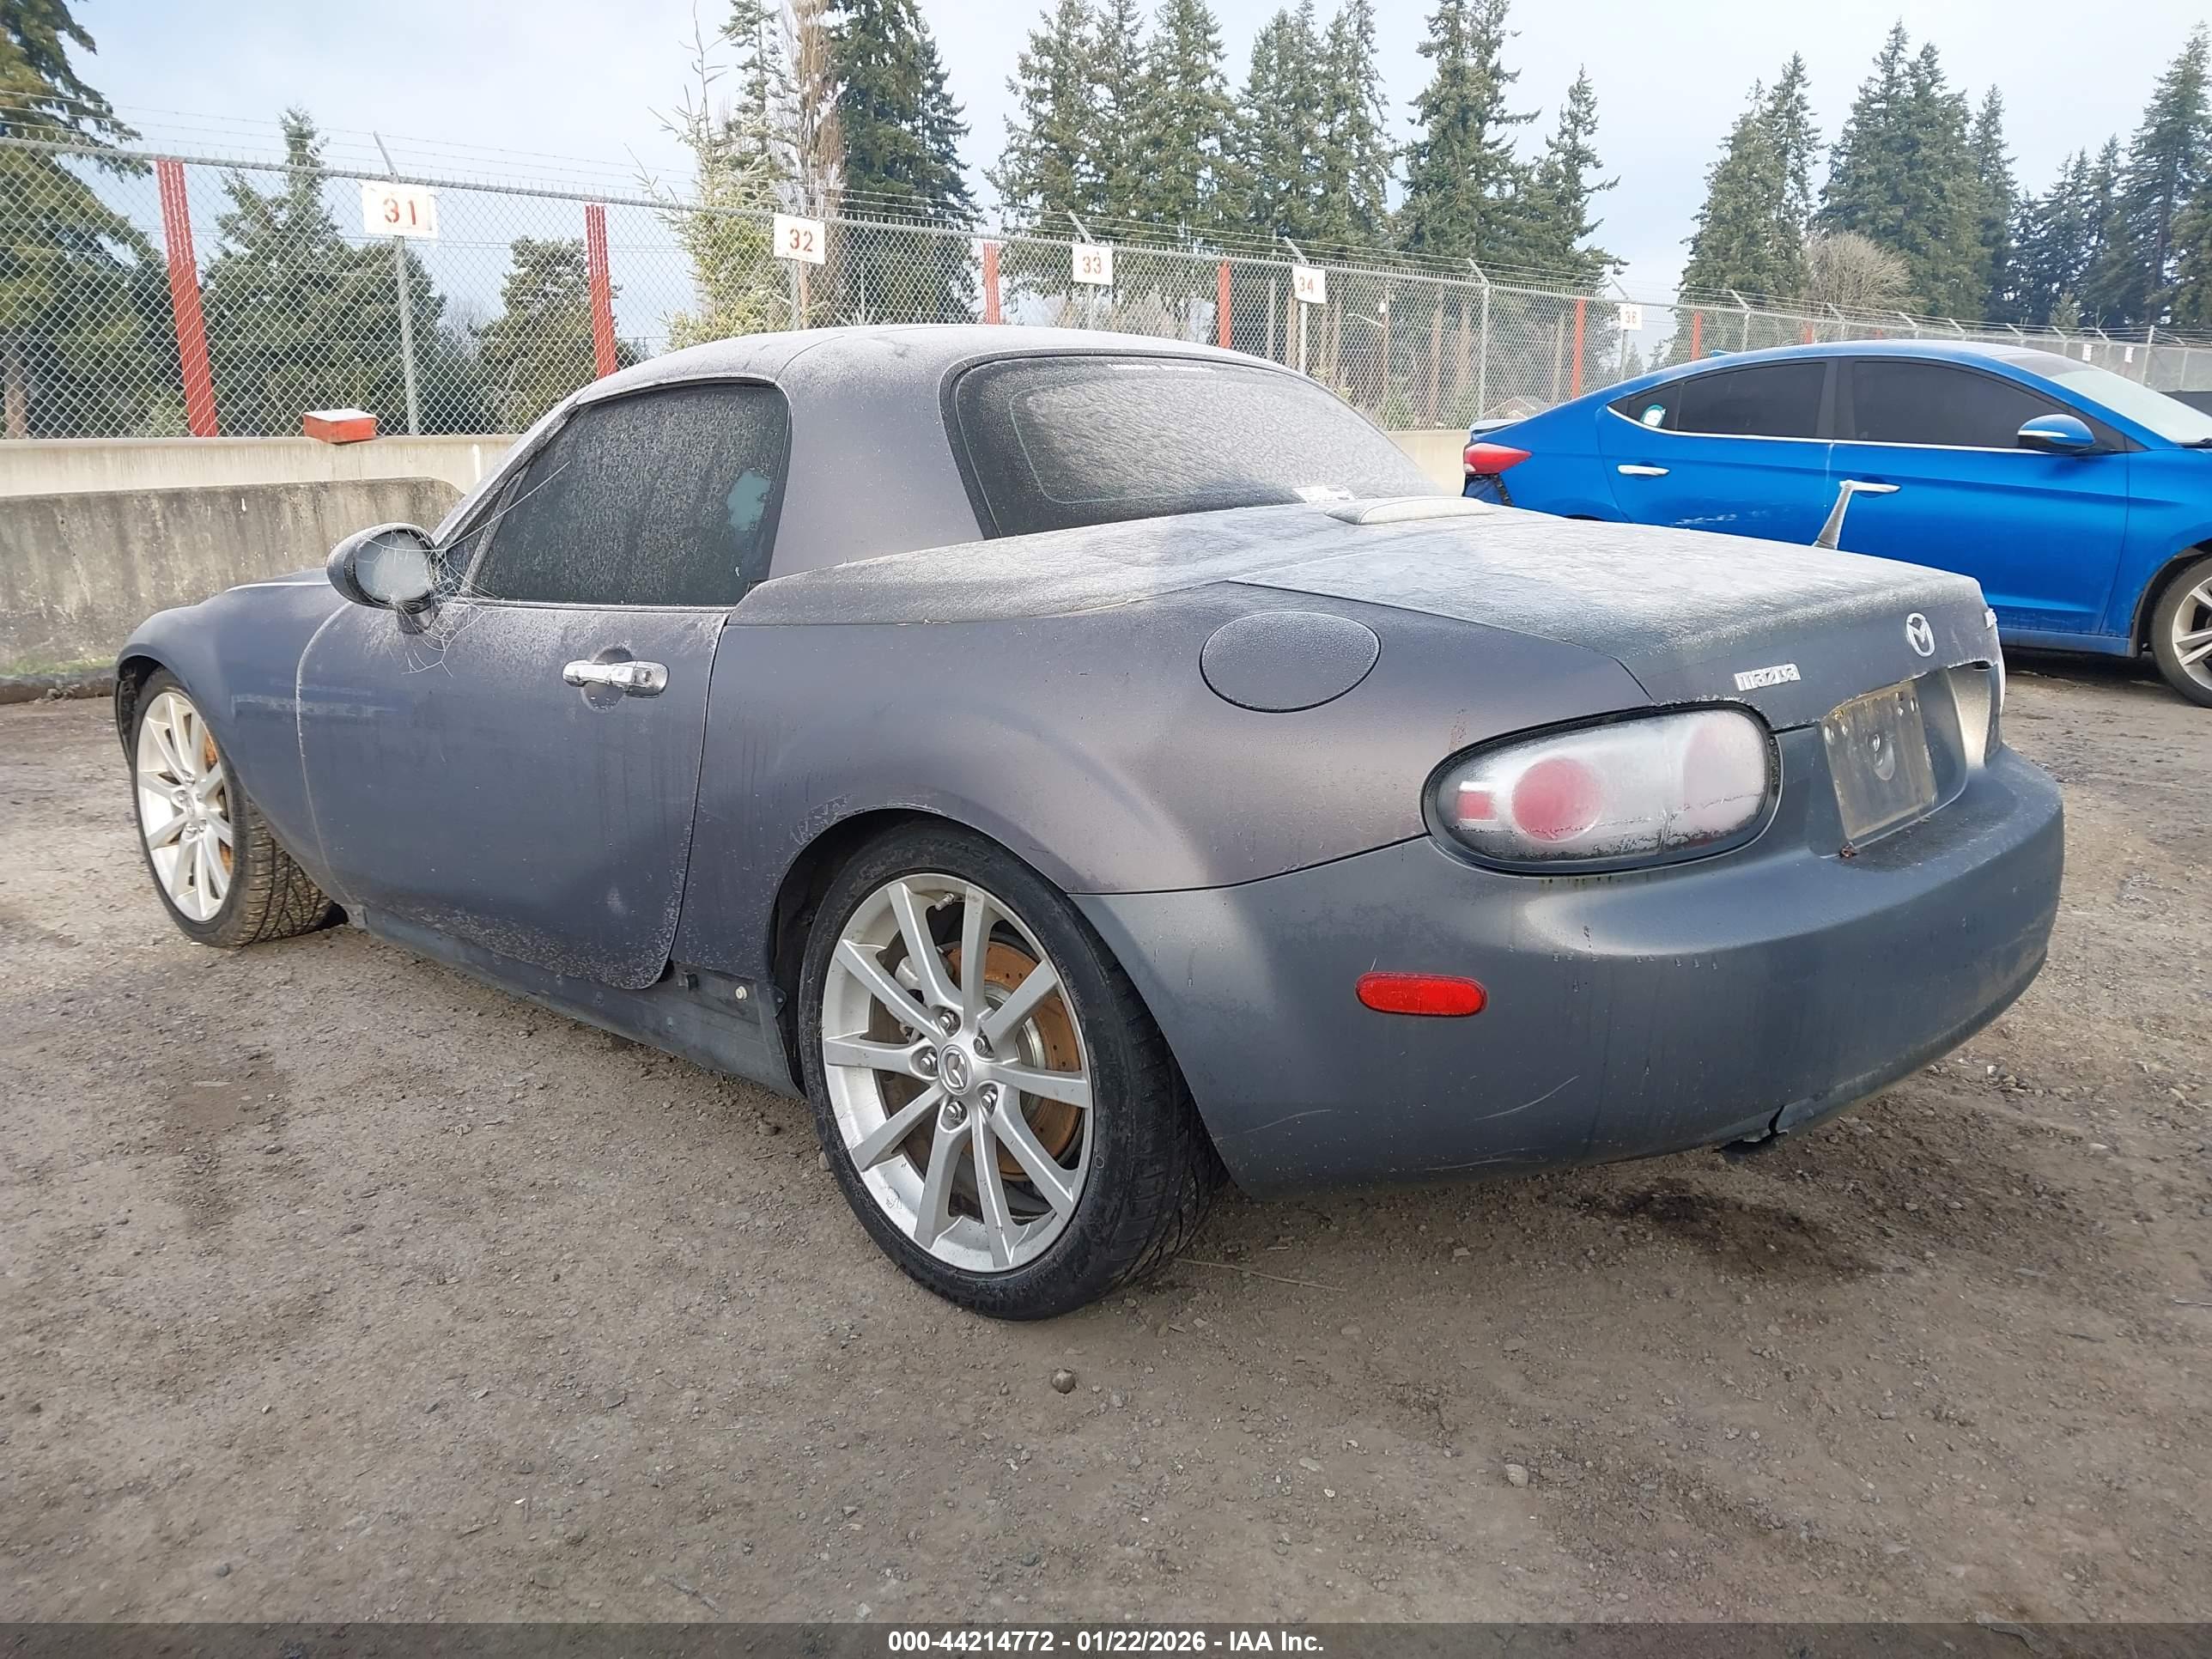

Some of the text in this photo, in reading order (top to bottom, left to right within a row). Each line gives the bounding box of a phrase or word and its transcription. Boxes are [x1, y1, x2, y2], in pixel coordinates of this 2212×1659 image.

[383, 198, 416, 225] 31
[790, 228, 813, 252] 32
[1083, 256, 1102, 274] 33
[1299, 276, 1314, 295] 34
[1734, 664, 1801, 691] mazda
